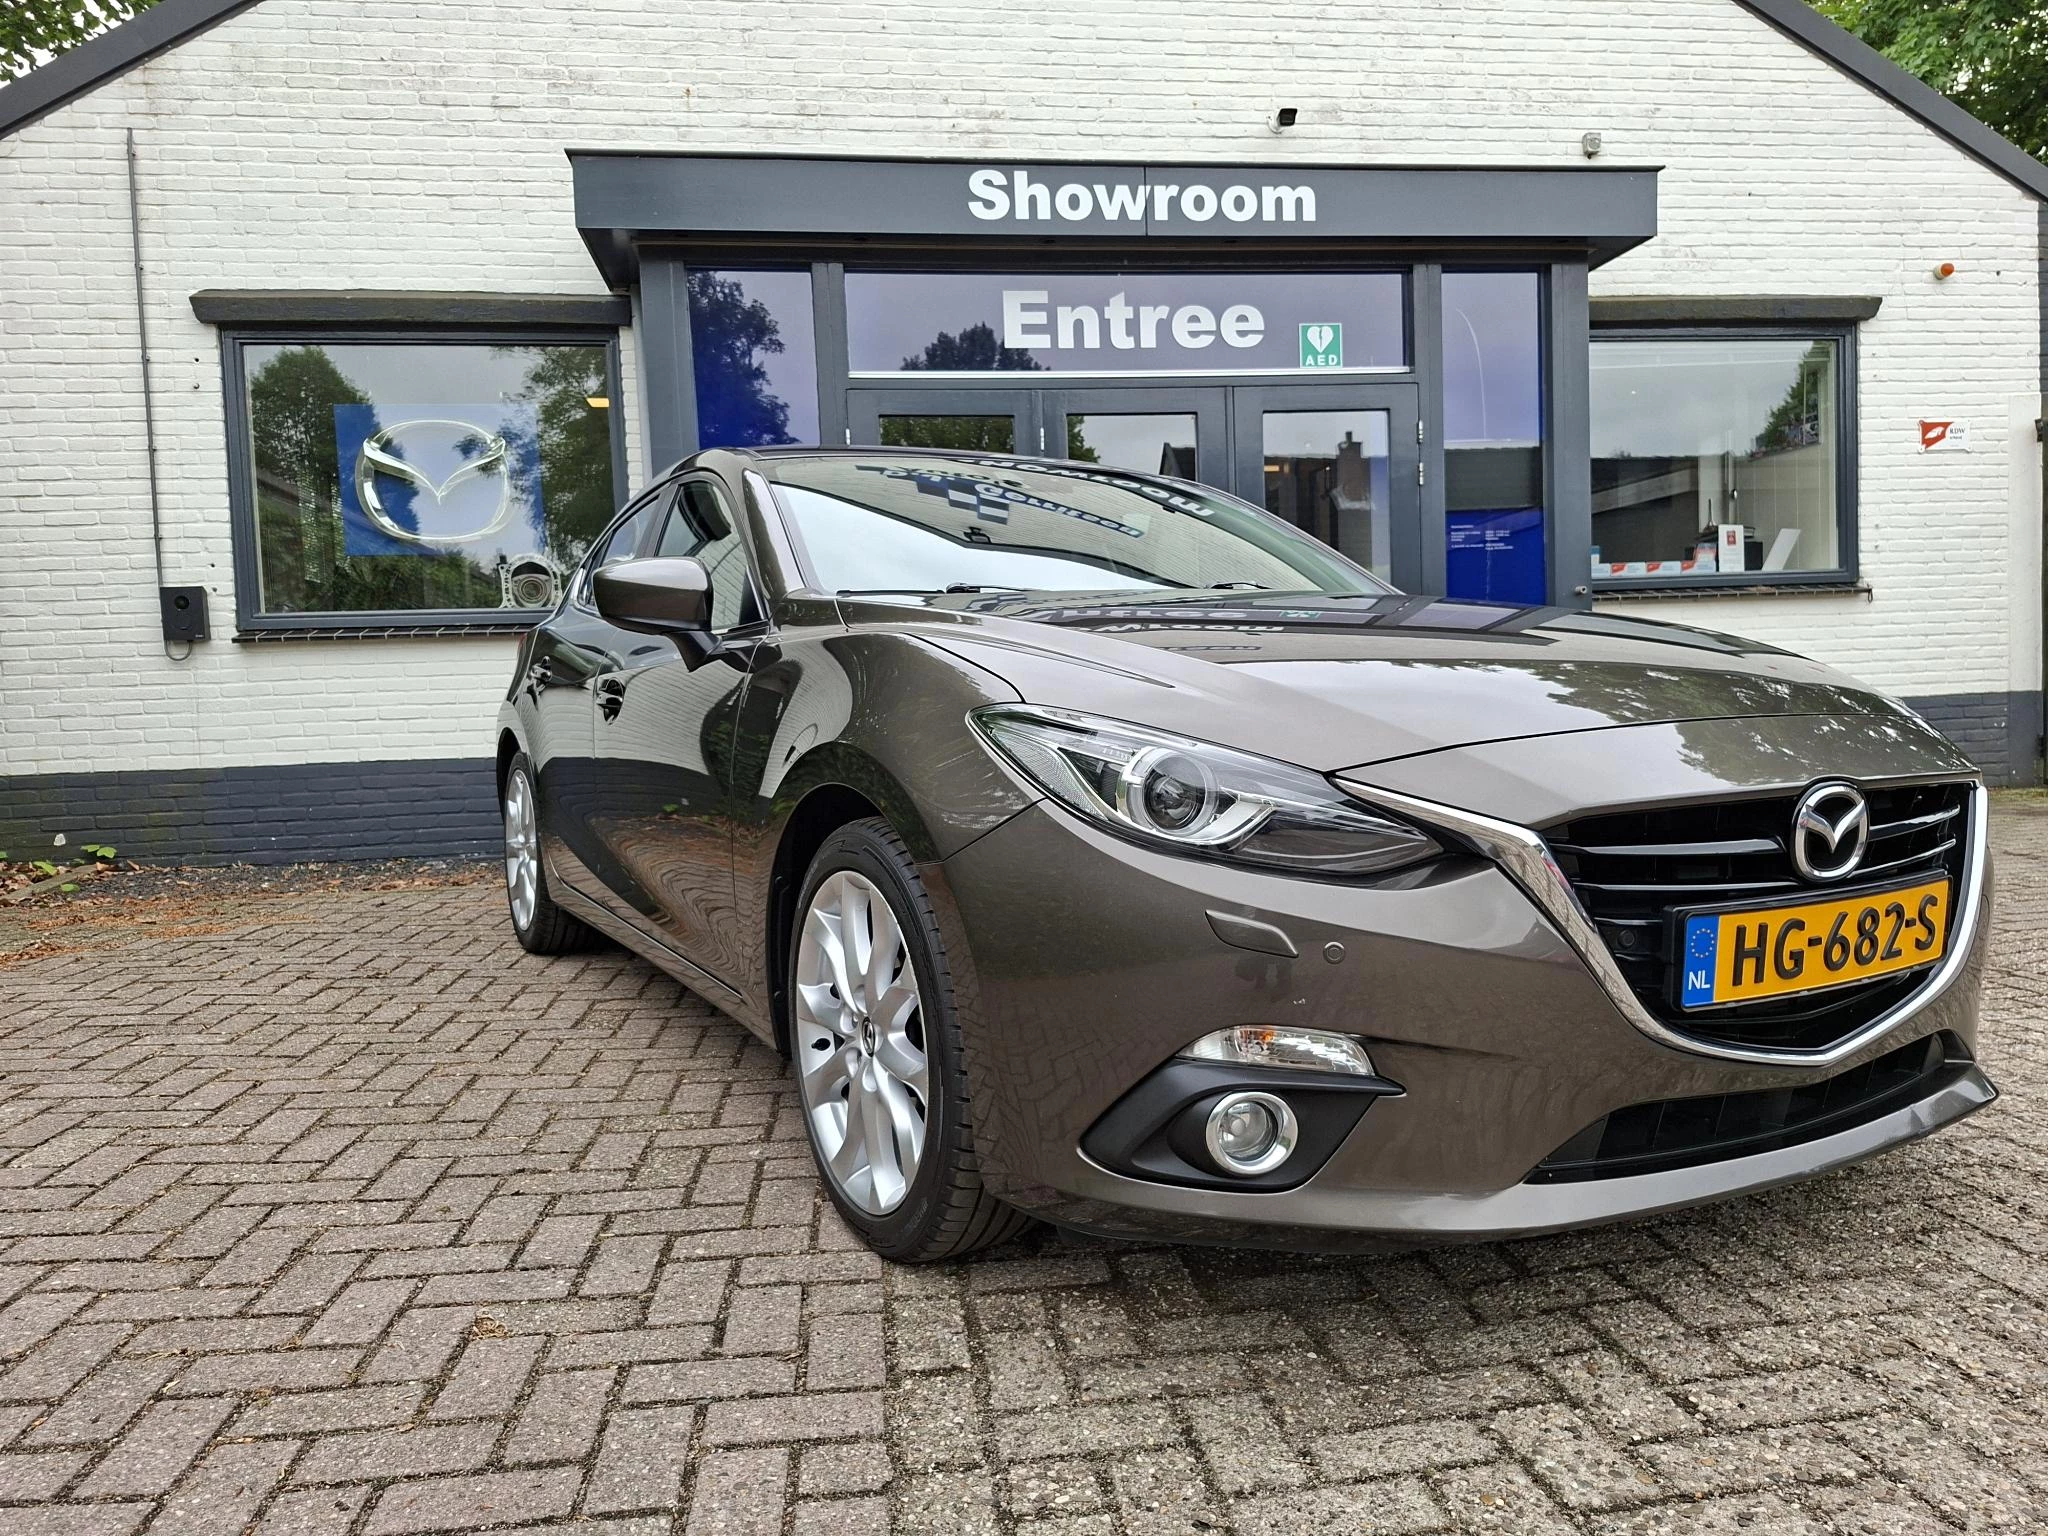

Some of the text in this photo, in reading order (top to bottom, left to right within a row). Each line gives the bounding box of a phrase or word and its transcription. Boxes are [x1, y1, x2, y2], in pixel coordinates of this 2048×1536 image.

[968, 169, 1316, 222] Showroom
[1003, 290, 1265, 349] Entree
[1305, 354, 1338, 366] AED
[1732, 894, 1938, 986] HG-682-S
[1688, 971, 1710, 990] NL
